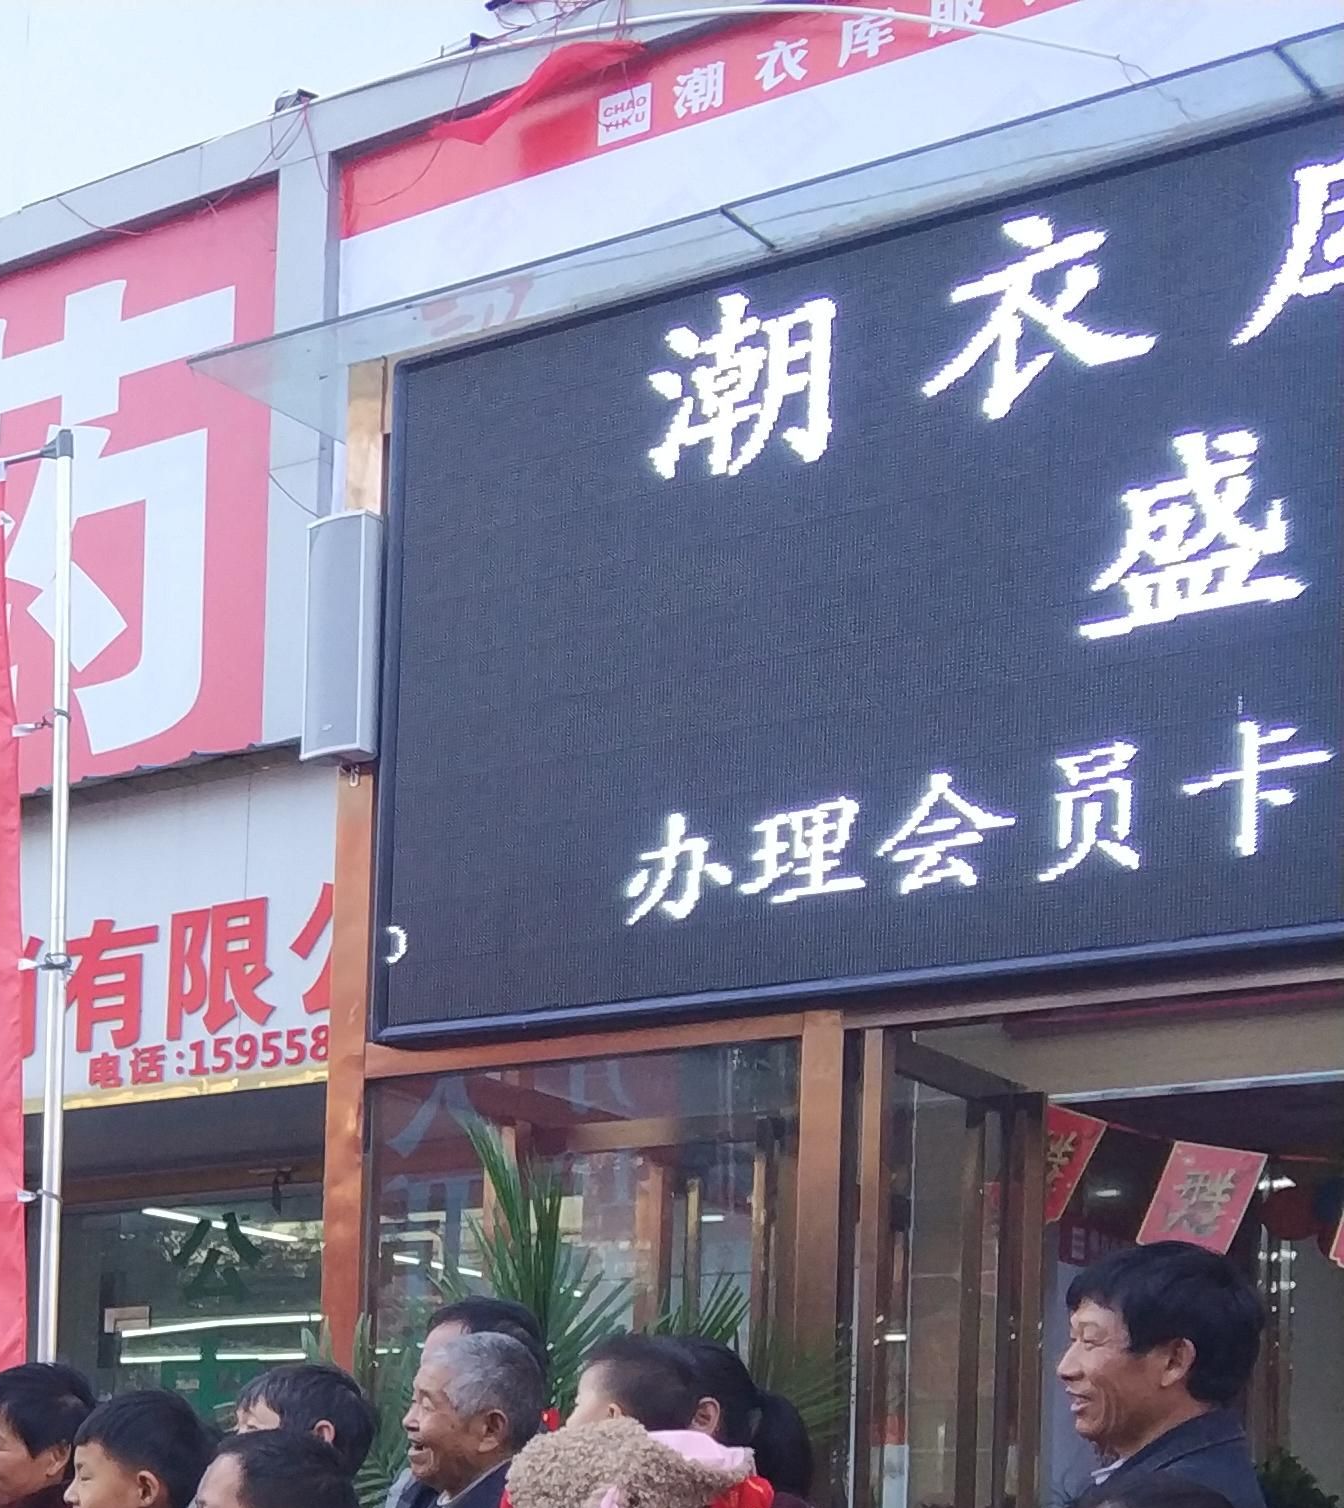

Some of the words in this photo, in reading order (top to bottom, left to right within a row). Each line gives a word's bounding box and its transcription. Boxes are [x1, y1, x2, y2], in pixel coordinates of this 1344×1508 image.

[602, 95, 647, 119] CHAO
[1078, 428, 1308, 641] 盛
[625, 718, 1334, 927] 办理会员卡
